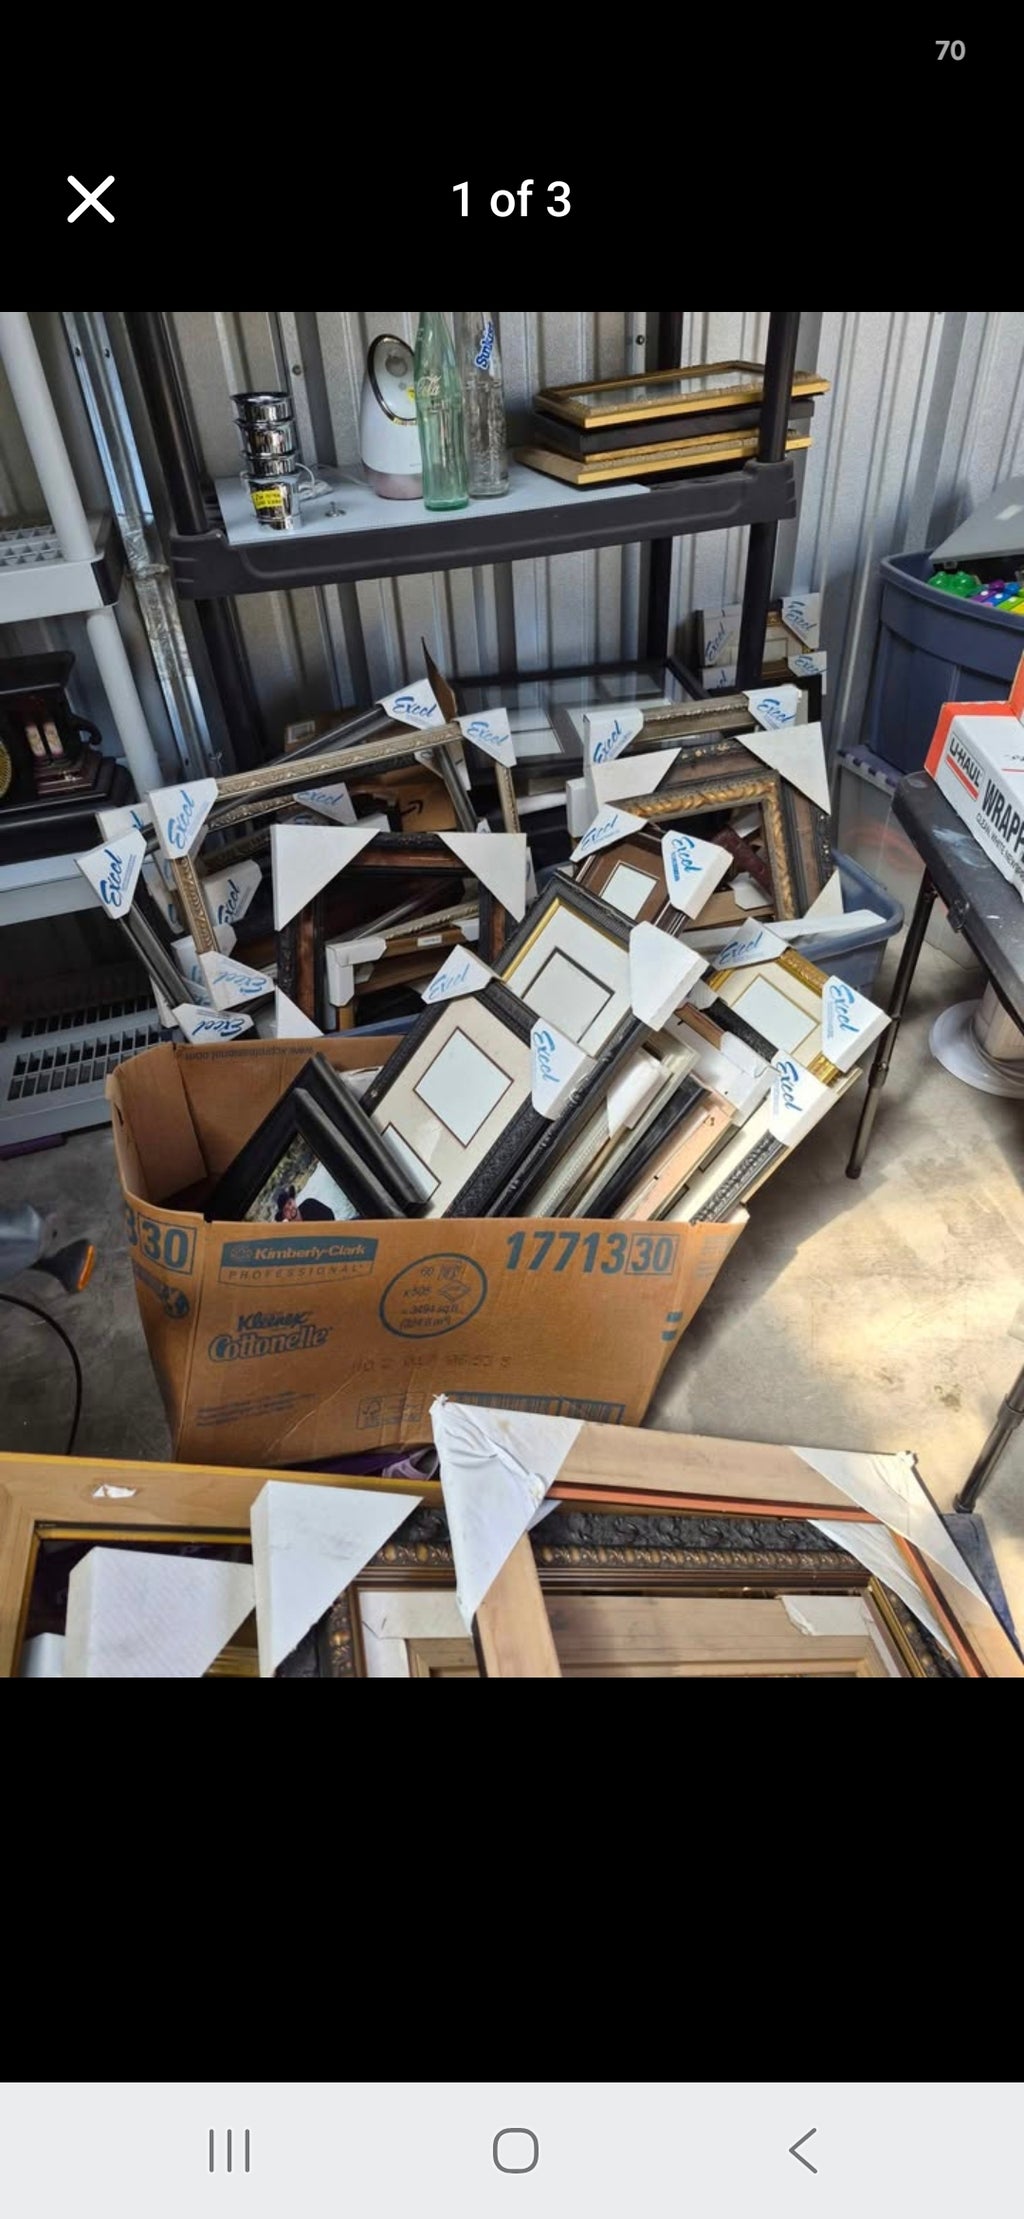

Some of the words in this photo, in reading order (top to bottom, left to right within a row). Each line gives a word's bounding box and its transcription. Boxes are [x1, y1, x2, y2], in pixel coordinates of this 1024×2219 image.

[705, 621, 726, 661] Excel
[392, 695, 438, 718] Excel
[757, 698, 797, 722] Excel
[466, 720, 509, 746] Excel
[592, 719, 623, 764] Excel
[949, 737, 981, 788] U-HAUL
[168, 789, 195, 850] Excel
[581, 814, 619, 851] Excel
[671, 836, 703, 873] Excel
[100, 848, 123, 908] Excel
[217, 878, 240, 925] Excel
[718, 931, 764, 966] Excel
[212, 971, 267, 994] Excel
[428, 962, 471, 1001] Excel
[191, 1018, 245, 1037] Excel
[829, 983, 861, 1036] Excel
[532, 1029, 561, 1083] Excel
[777, 1060, 804, 1113] Excel
[141, 1220, 190, 1270] 30
[254, 1243, 366, 1261] Kimberly-Clark
[505, 1230, 629, 1274] 17713
[631, 1236, 675, 1273] 30
[228, 1263, 361, 1280] PROFESSIONAL
[237, 1311, 310, 1332] Kleenex
[208, 1323, 329, 1363] Cottonelle
